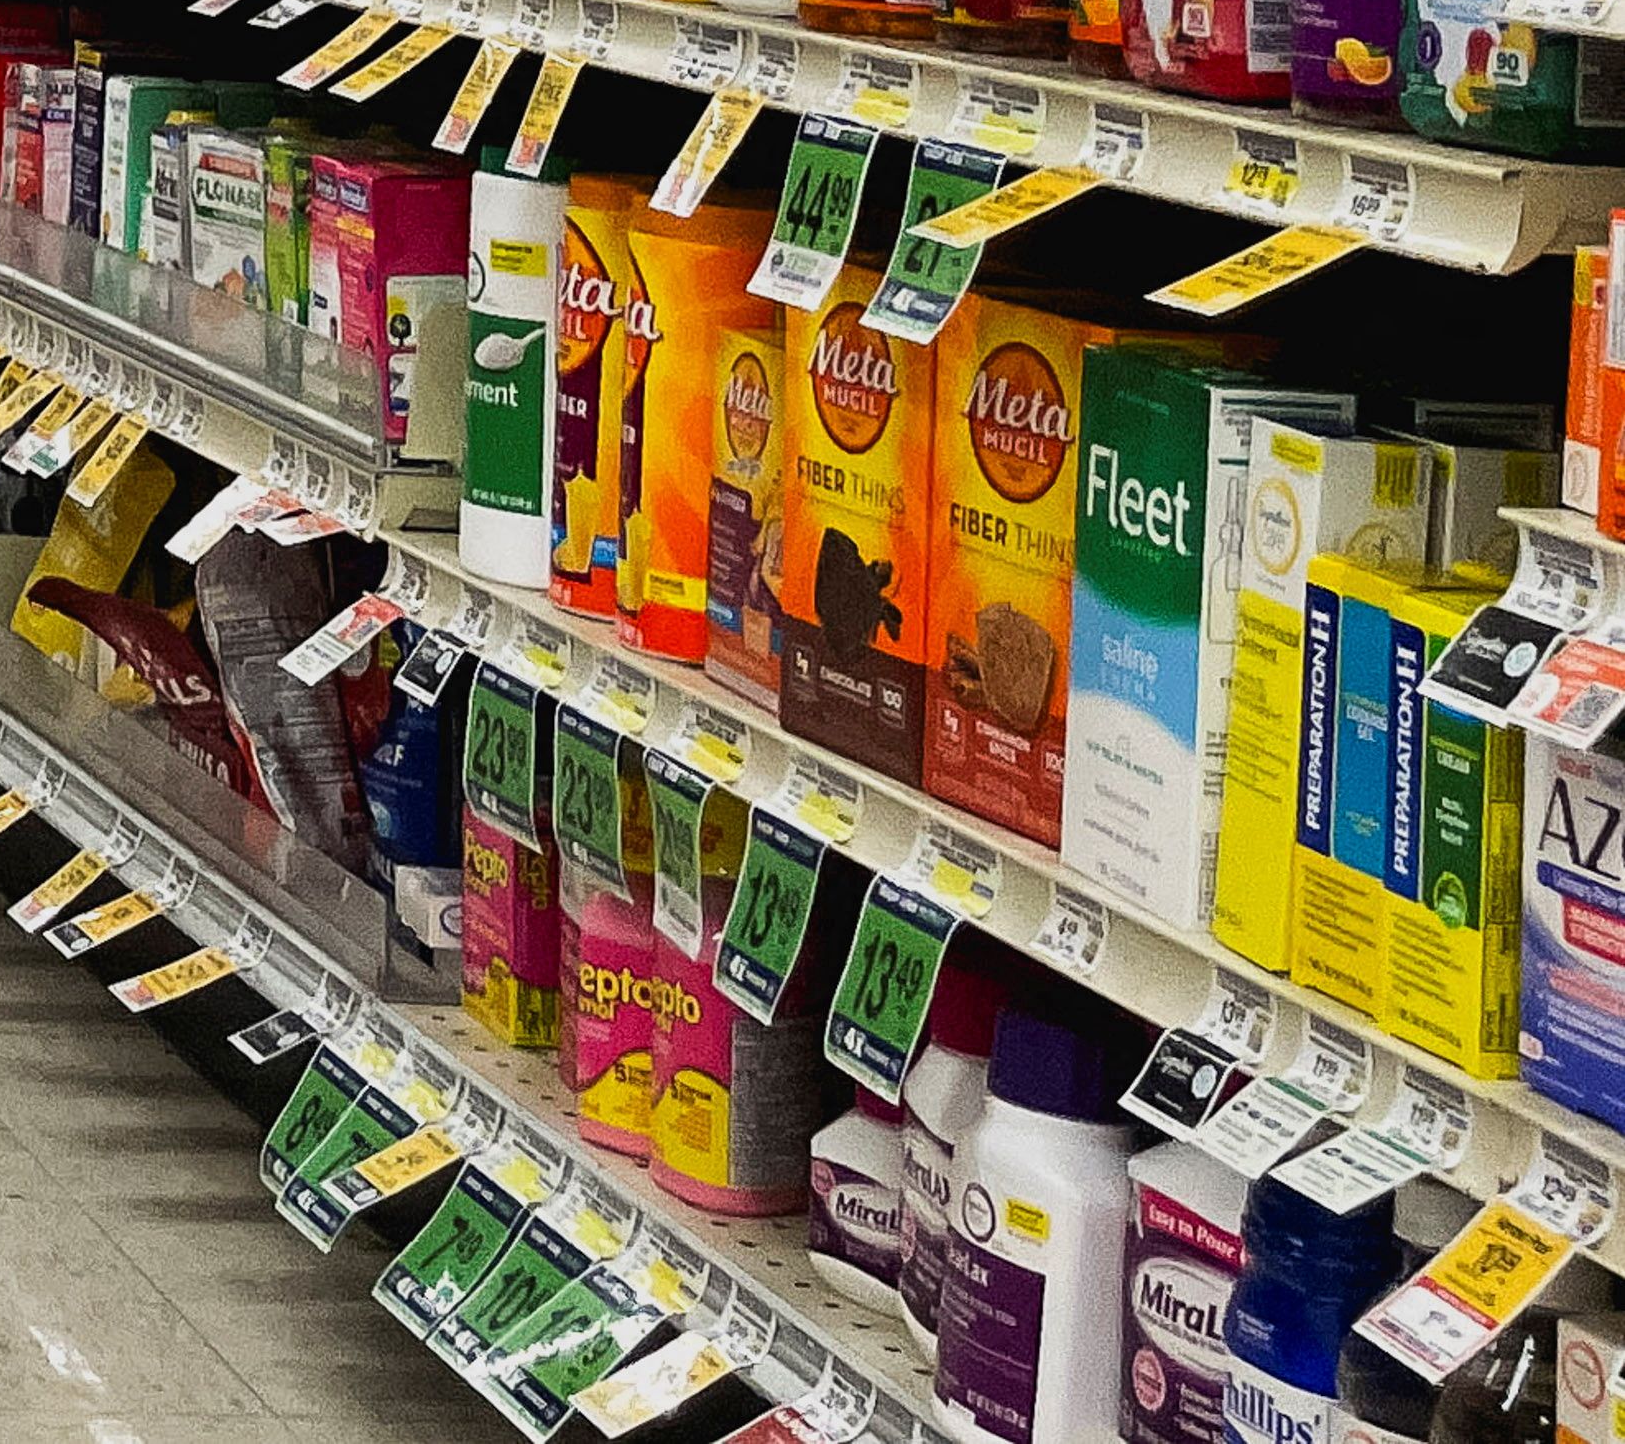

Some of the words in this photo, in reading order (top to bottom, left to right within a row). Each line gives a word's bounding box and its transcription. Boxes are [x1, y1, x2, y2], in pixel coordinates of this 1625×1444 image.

[1496, 53, 1520, 72] 90
[809, 330, 899, 397] Meta
[823, 381, 880, 414] MUCIL
[961, 370, 1074, 444] Meta
[798, 455, 846, 495] FIBER
[1086, 443, 1193, 556] Fleet
[949, 504, 1008, 547] FIBER
[1311, 607, 1332, 643] H
[1396, 645, 1418, 684] H
[1305, 663, 1331, 831] PREPARATION
[1392, 687, 1418, 875] PREPARATION
